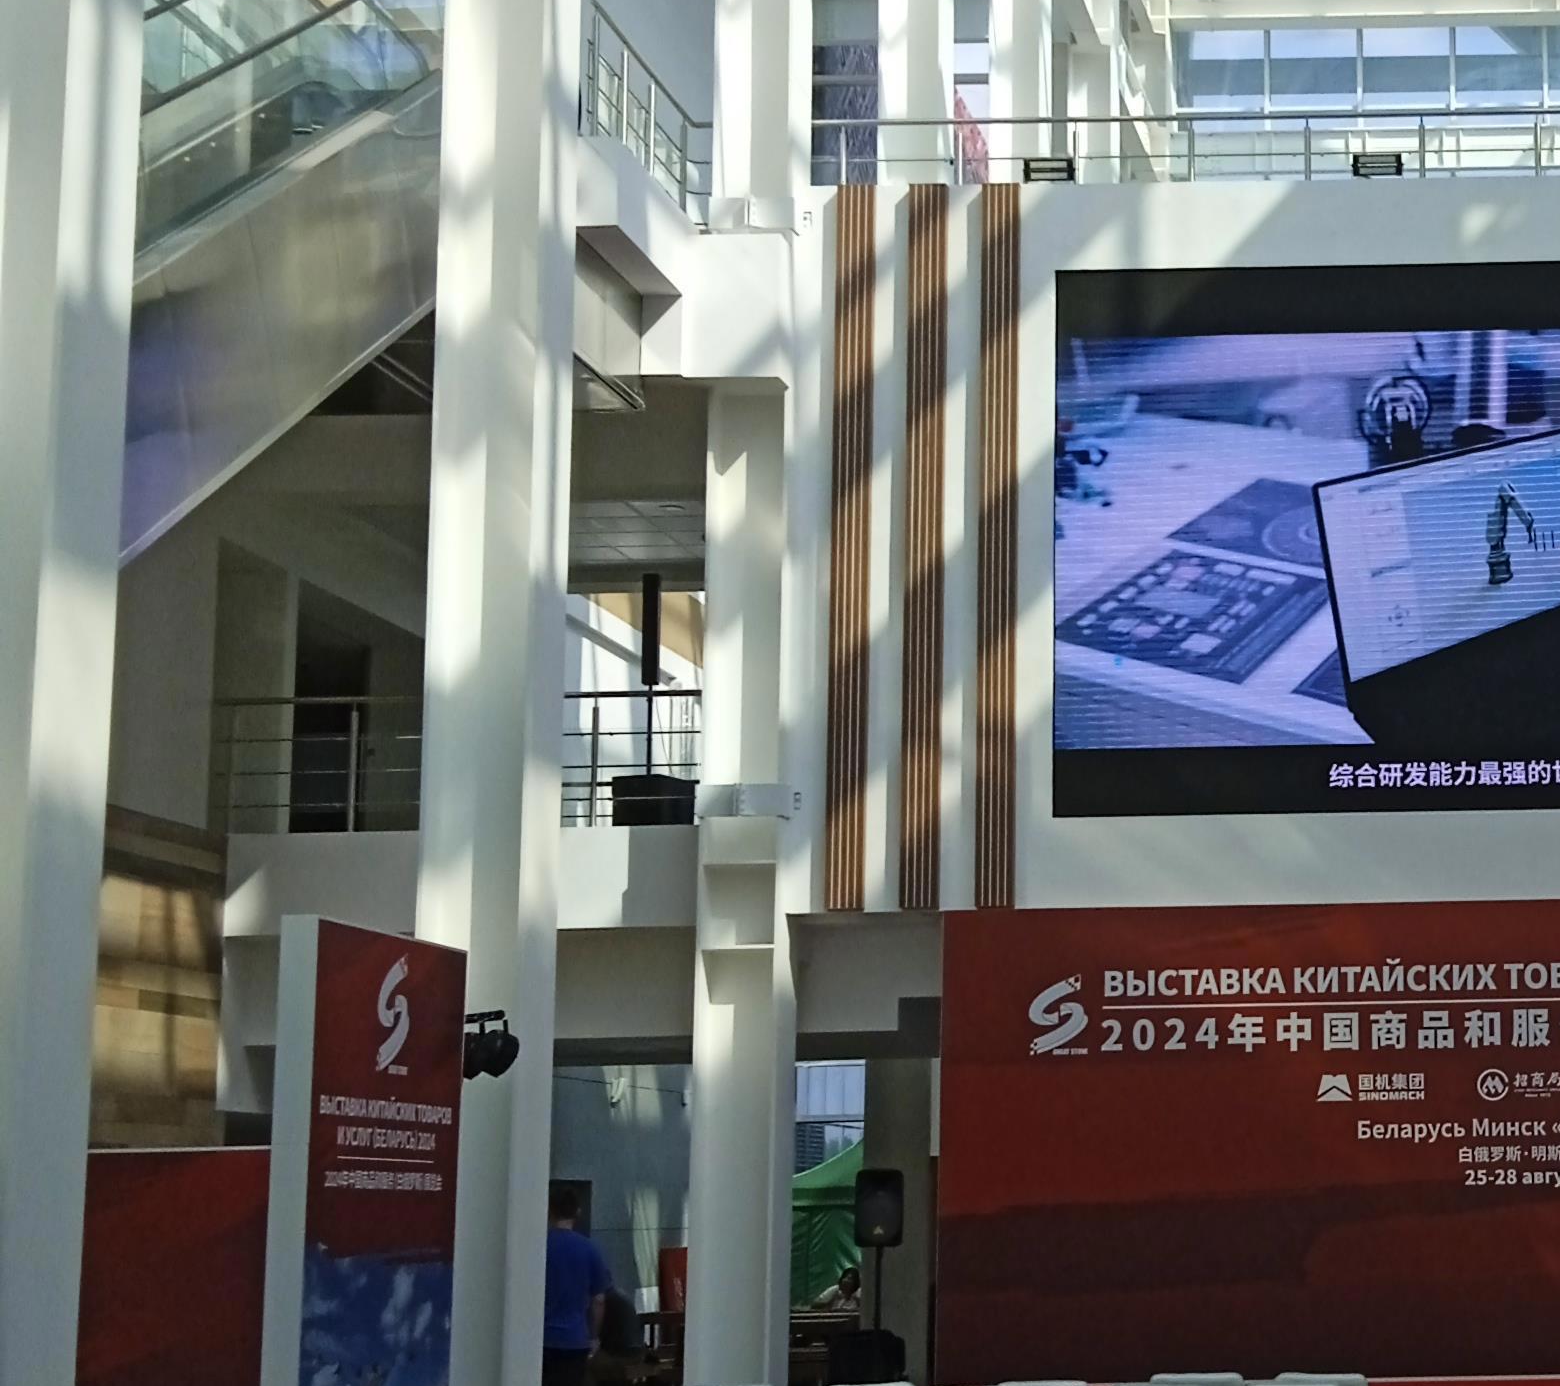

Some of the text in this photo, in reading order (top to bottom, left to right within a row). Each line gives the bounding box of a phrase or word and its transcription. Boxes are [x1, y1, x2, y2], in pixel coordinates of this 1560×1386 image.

[1103, 967, 1286, 997] ВЫСТАВКА
[1293, 957, 1497, 993] КИТАЙСКИХ
[1358, 1073, 1425, 1090] 国机集团
[1358, 1091, 1425, 1101] SINOMACH
[1357, 1119, 1466, 1143] Беларусь
[1472, 1118, 1546, 1138] Минск
[1464, 1168, 1518, 1186] 25-28
